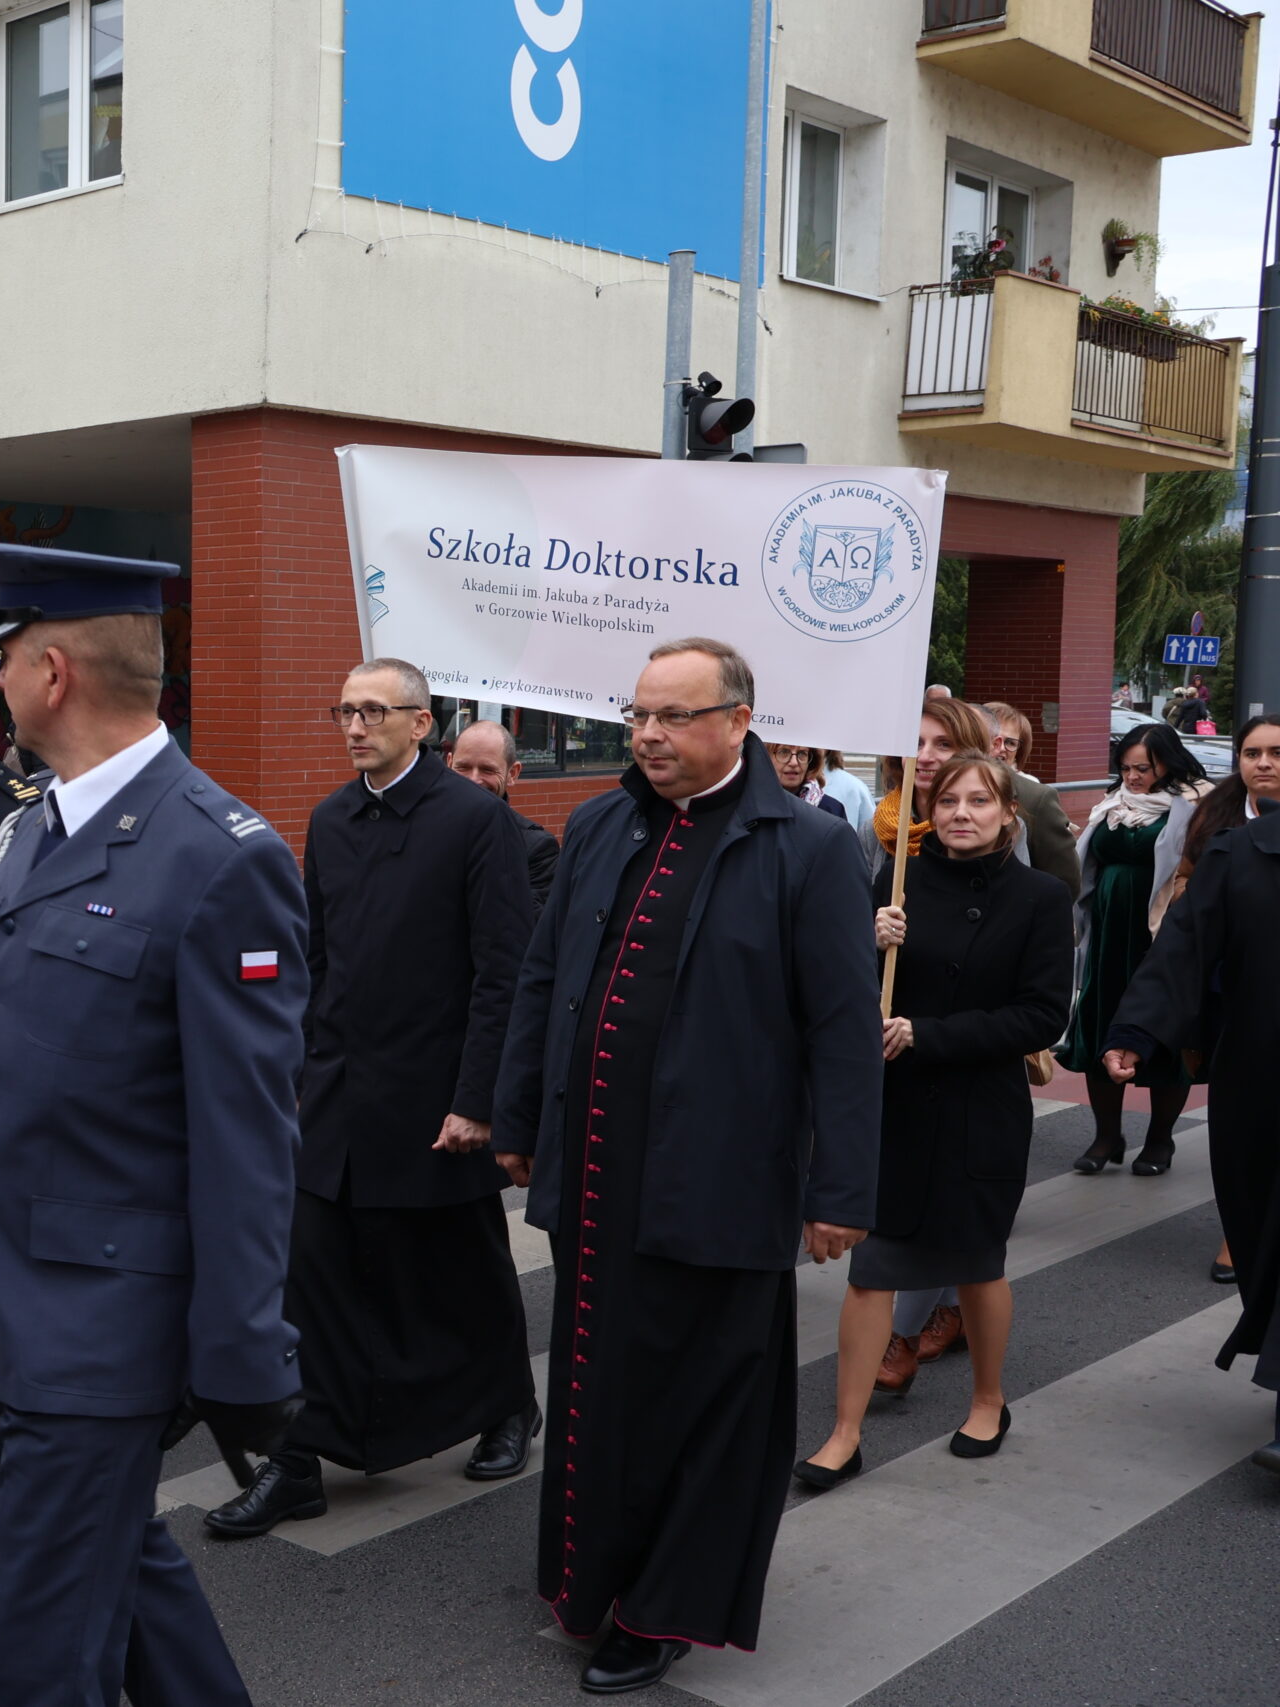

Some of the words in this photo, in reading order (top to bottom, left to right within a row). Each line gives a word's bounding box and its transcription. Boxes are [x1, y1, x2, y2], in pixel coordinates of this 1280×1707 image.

[769, 503, 808, 564] AKADEMIA
[807, 493, 826, 507] IM.
[829, 487, 883, 504] JAKUBA
[883, 498, 894, 509] Z
[892, 505, 924, 572] PARADYŻA
[426, 526, 531, 568] Szkoła
[543, 538, 740, 587] Doktorska
[461, 577, 519, 597] Akademii
[522, 585, 541, 599] im.
[544, 587, 589, 605] Jakuba
[592, 596, 600, 606] z
[604, 593, 670, 614] Paradyża
[777, 586, 788, 598] W
[783, 595, 827, 630] GORZOWIE
[829, 593, 907, 632] WIELKOPOLSKIM
[475, 604, 485, 614] w
[488, 602, 548, 622] Gorzowie
[552, 610, 655, 634] Wielkopolskim
[1201, 654, 1217, 662] BUS
[489, 676, 594, 702] językoznawstwo
